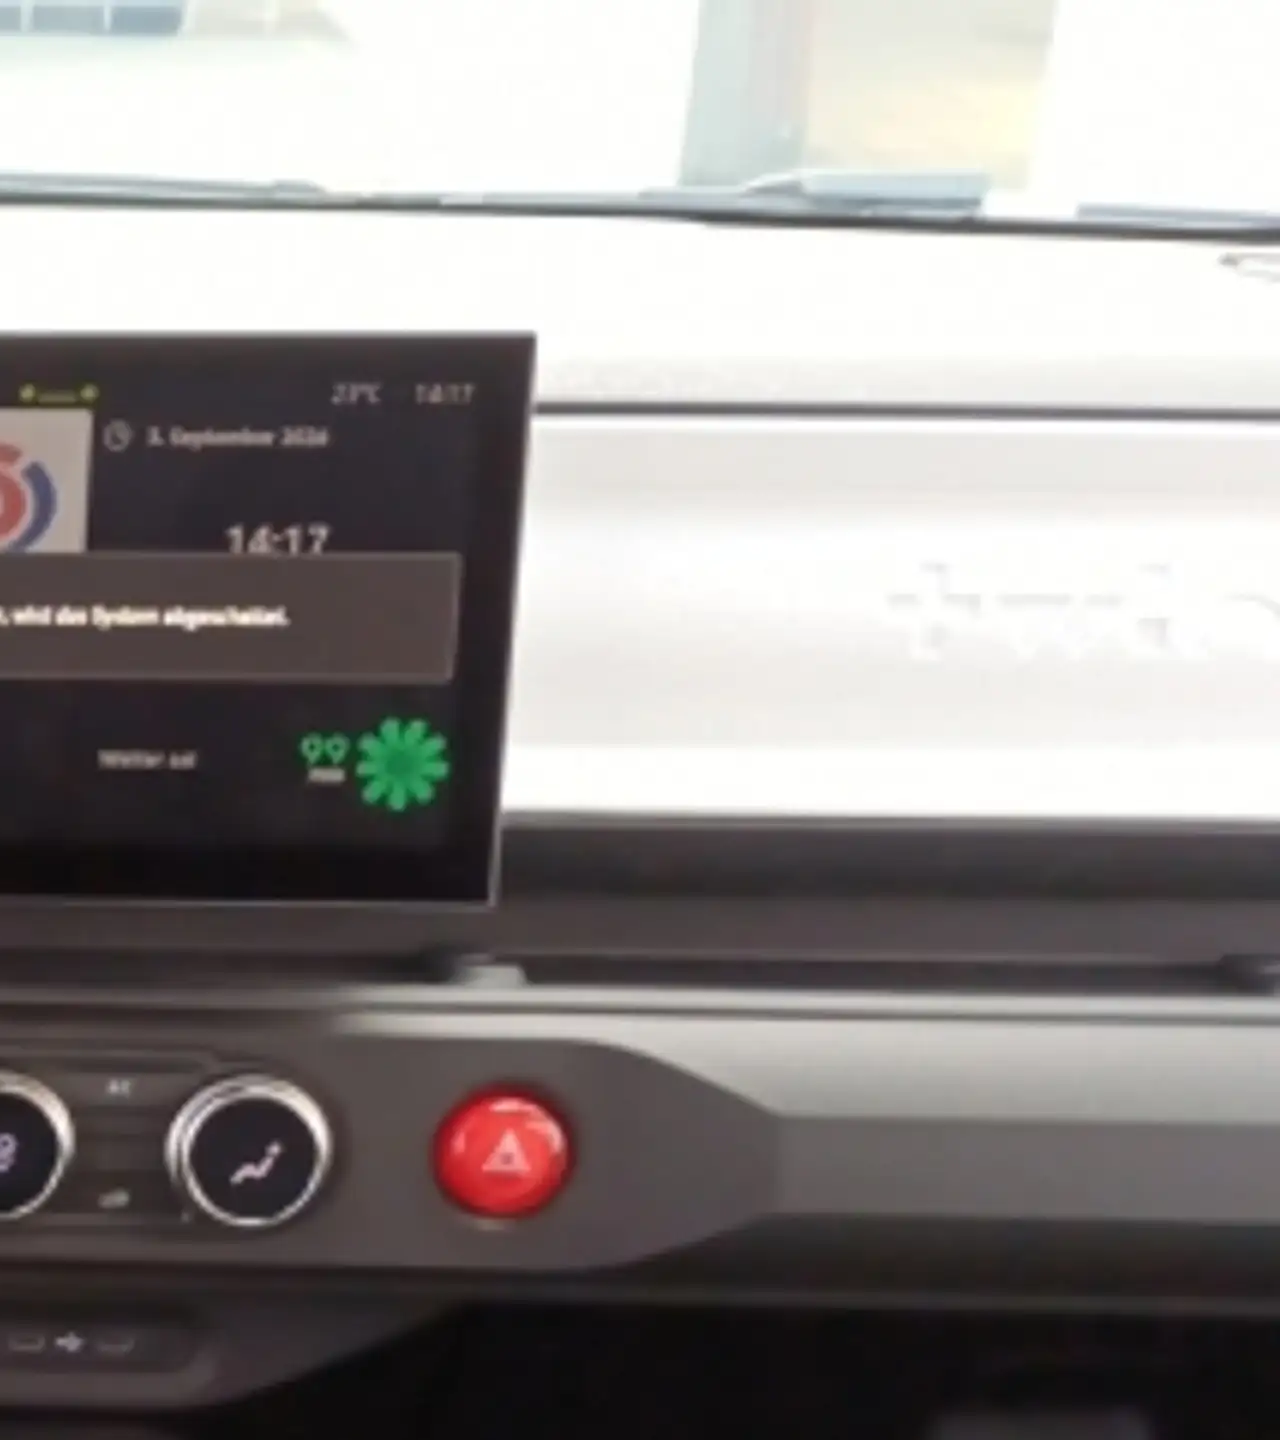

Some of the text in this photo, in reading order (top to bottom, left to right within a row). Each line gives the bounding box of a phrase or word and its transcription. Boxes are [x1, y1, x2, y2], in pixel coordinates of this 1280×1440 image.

[169, 425, 274, 451] September
[224, 521, 333, 554] 14:17
[13, 604, 52, 627] wird
[55, 604, 88, 627] das
[91, 604, 159, 631] System
